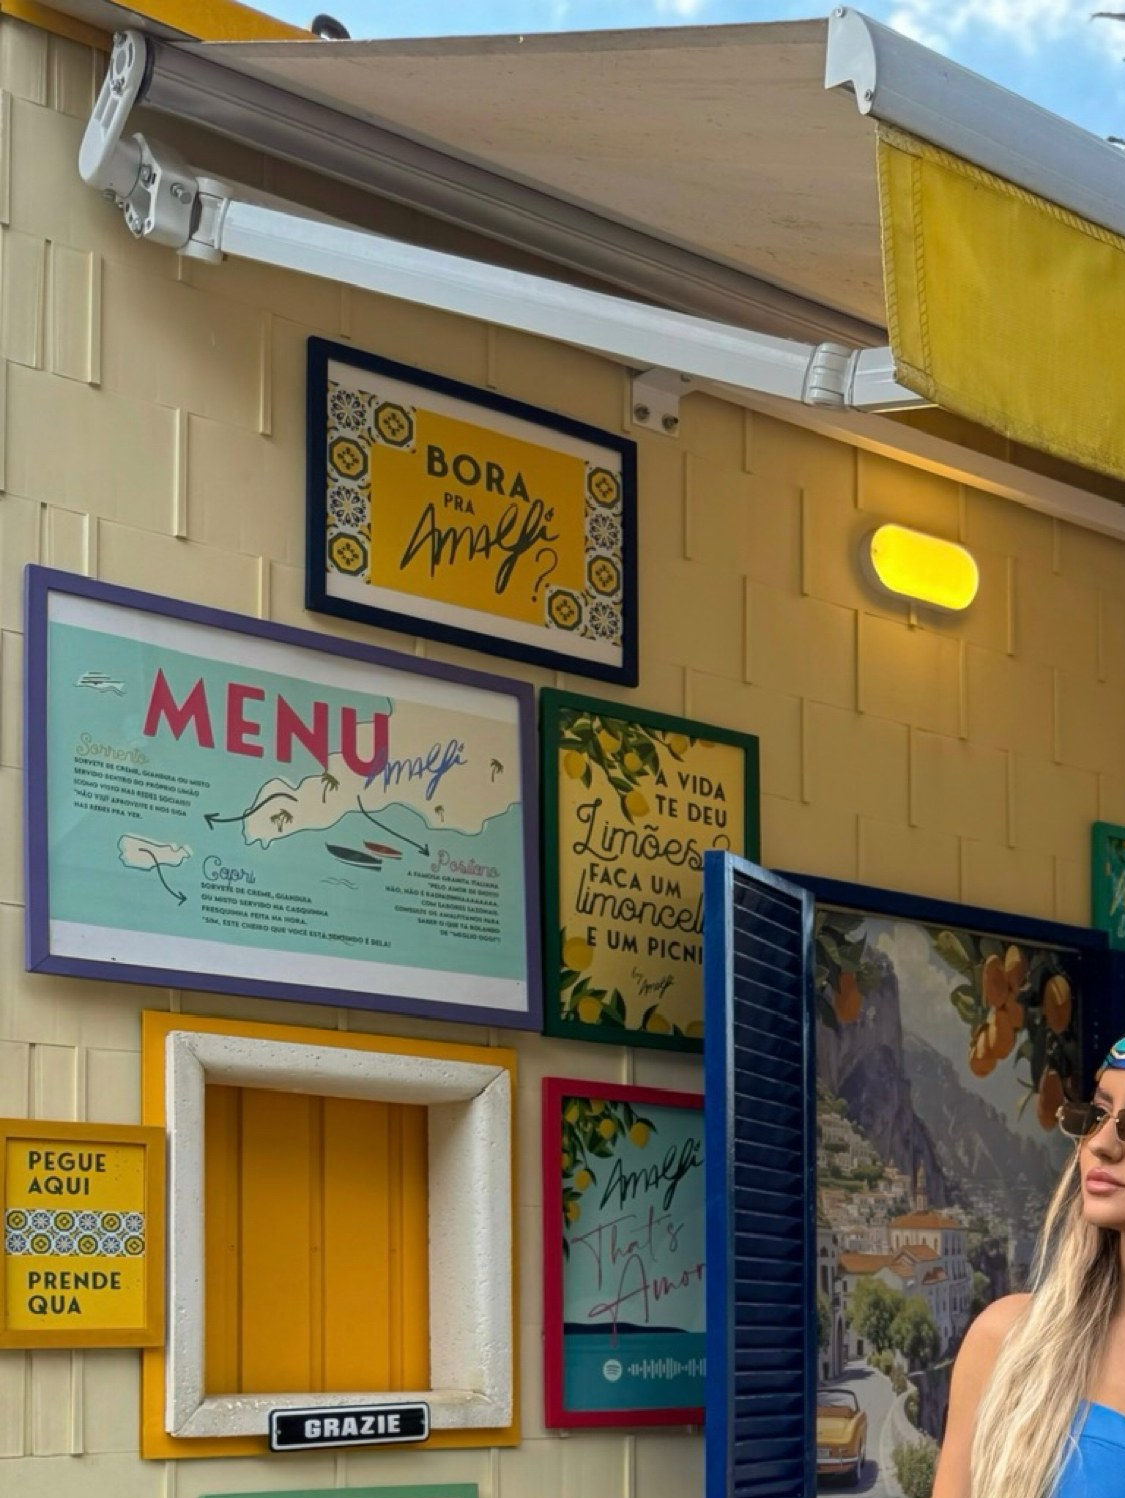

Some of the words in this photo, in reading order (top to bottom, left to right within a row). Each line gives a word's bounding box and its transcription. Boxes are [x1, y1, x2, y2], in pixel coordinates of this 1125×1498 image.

[427, 444, 530, 502] BORA
[444, 491, 475, 515] PRA
[143, 667, 389, 777] MENU
[76, 732, 149, 765] Sorrento
[364, 739, 468, 800] Amalfi
[655, 768, 668, 788] A
[677, 771, 726, 801] VIDA
[655, 793, 678, 818] TE
[687, 802, 727, 828] DEU
[202, 855, 256, 886] Capri
[652, 875, 681, 898] UM
[576, 868, 705, 935] limoncel
[586, 926, 597, 947] E
[607, 929, 638, 954] UM
[648, 936, 703, 965] PICNI
[28, 1150, 106, 1173] PEGUE
[600, 1137, 704, 1211] Amalfi
[28, 1176, 90, 1195] AQUI
[28, 1271, 121, 1290] PRENDE
[28, 1295, 82, 1315] QUA
[588, 1254, 707, 1347] Amor
[304, 1414, 401, 1439] GRAZIE
